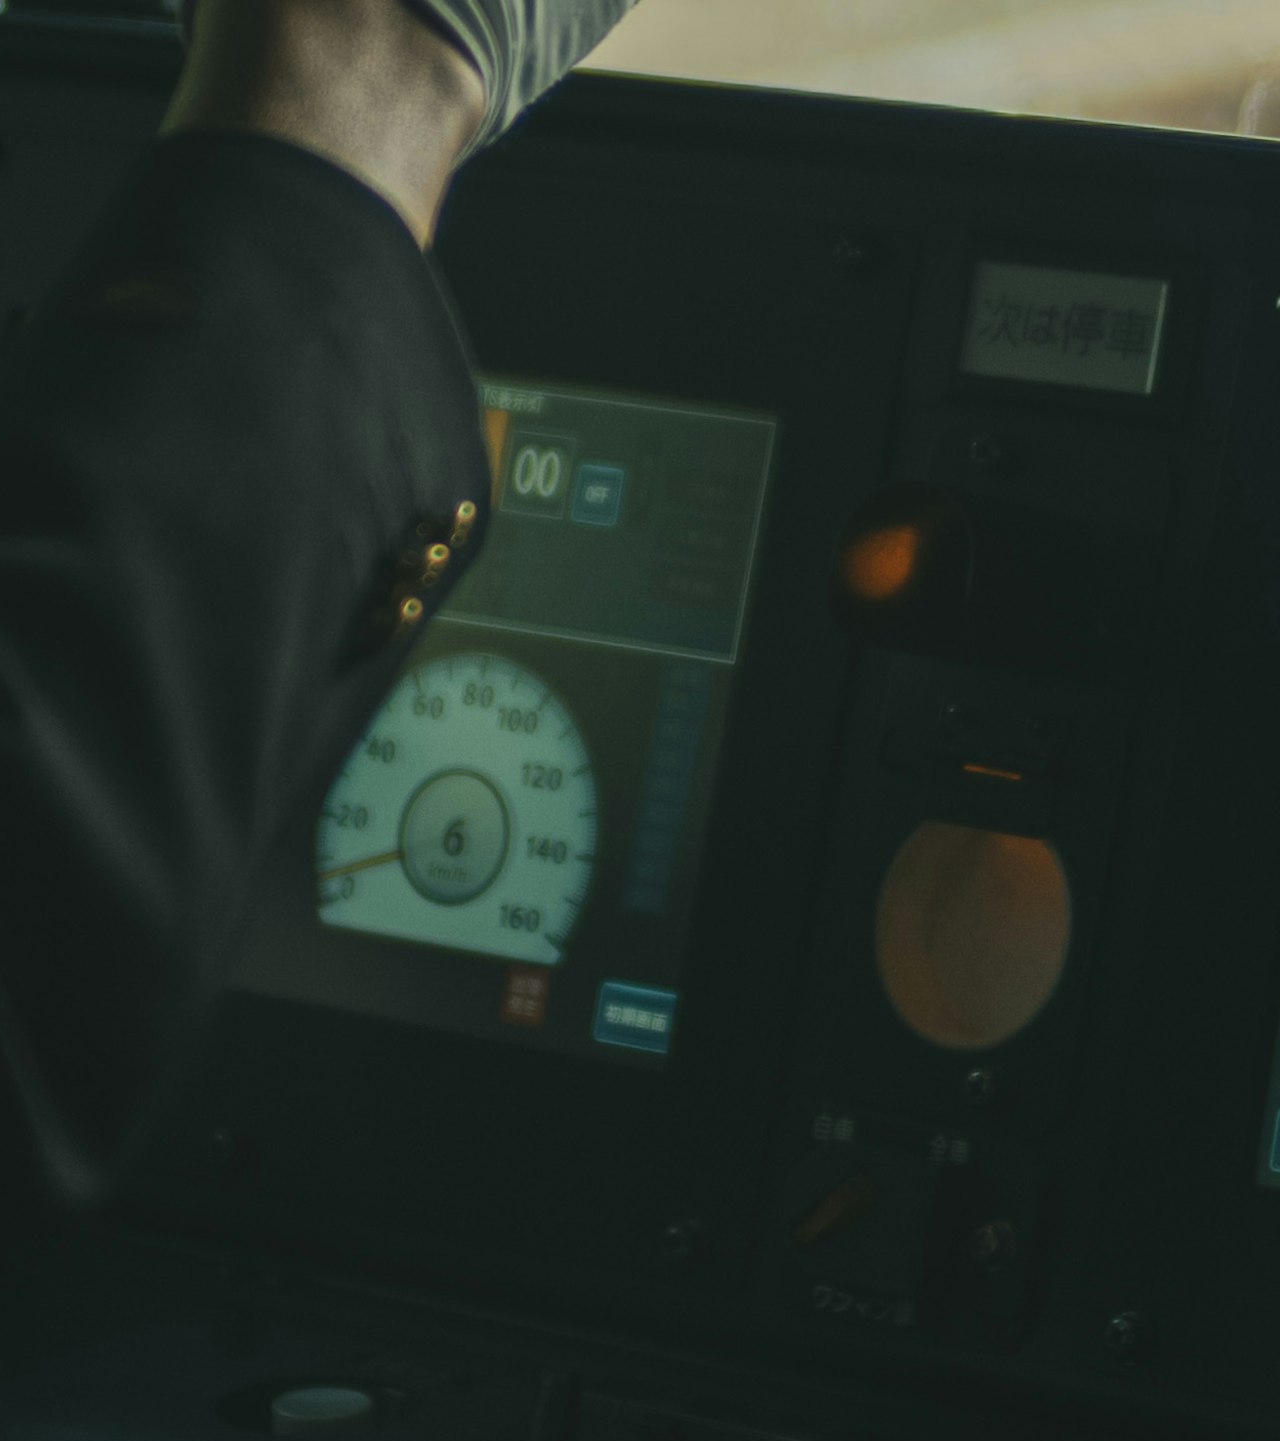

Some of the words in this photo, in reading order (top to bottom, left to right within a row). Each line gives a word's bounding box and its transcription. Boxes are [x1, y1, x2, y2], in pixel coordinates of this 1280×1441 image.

[976, 294, 1153, 361] 次は停車
[513, 447, 561, 498] 00
[412, 695, 445, 720] 60
[463, 682, 495, 709] 80
[498, 707, 538, 735] 100
[366, 739, 396, 764] 40
[521, 762, 563, 792] 120
[336, 805, 369, 831] 20
[442, 818, 466, 857] 6
[526, 836, 568, 864] 140
[340, 876, 355, 900] 0
[500, 903, 541, 933] 160
